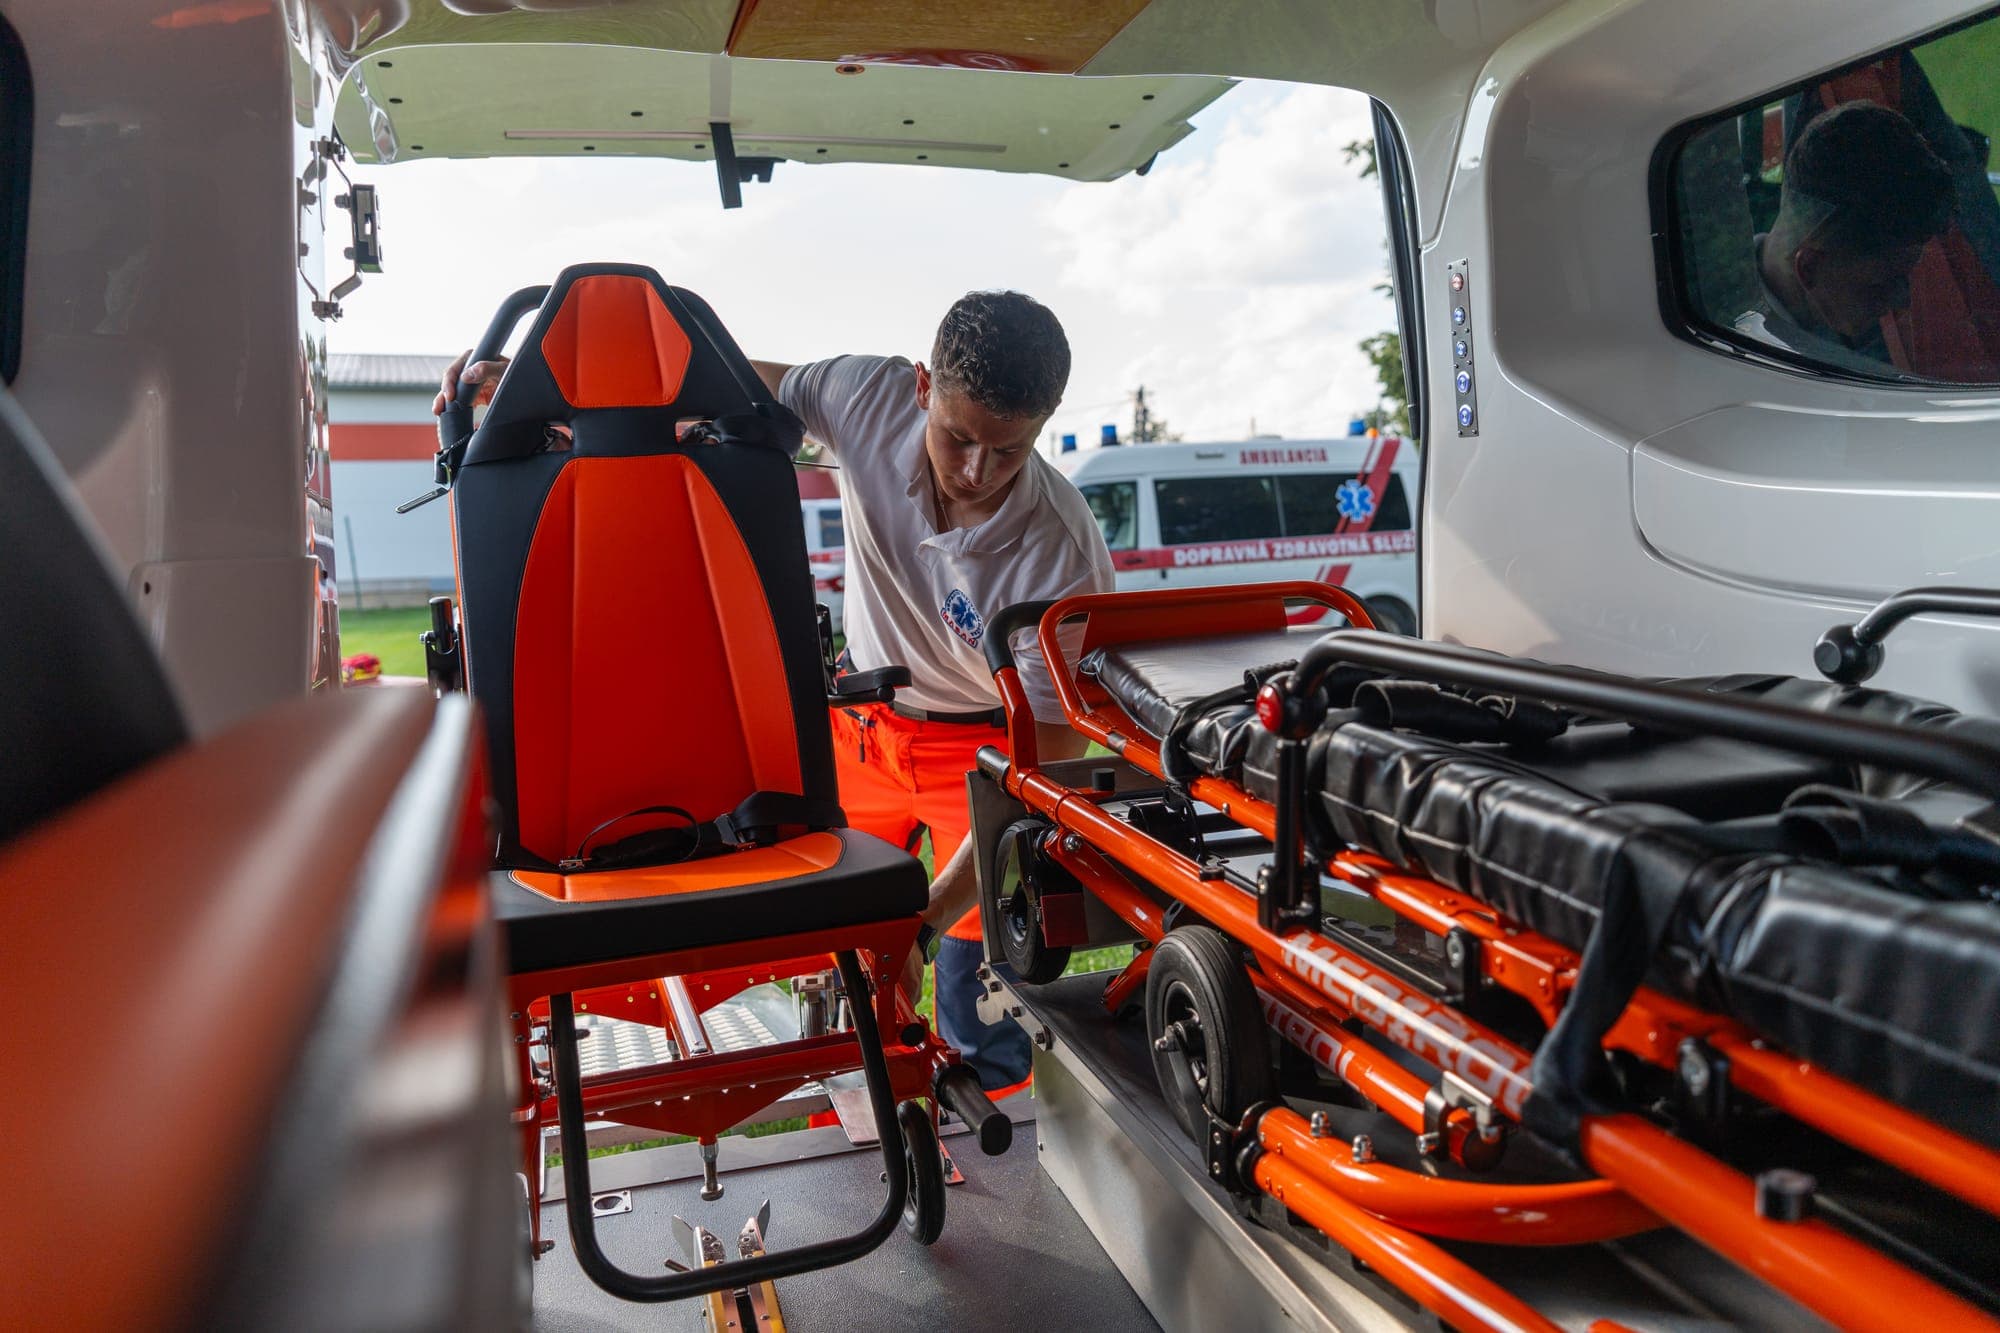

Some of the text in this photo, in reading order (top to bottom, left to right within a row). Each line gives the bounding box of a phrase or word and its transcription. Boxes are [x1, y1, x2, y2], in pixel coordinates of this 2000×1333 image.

[1240, 448, 1328, 465] AMBULANCIA
[1174, 531, 1413, 565] DOPRAVNÁ ZDRAVOTNÁ SLUŽ
